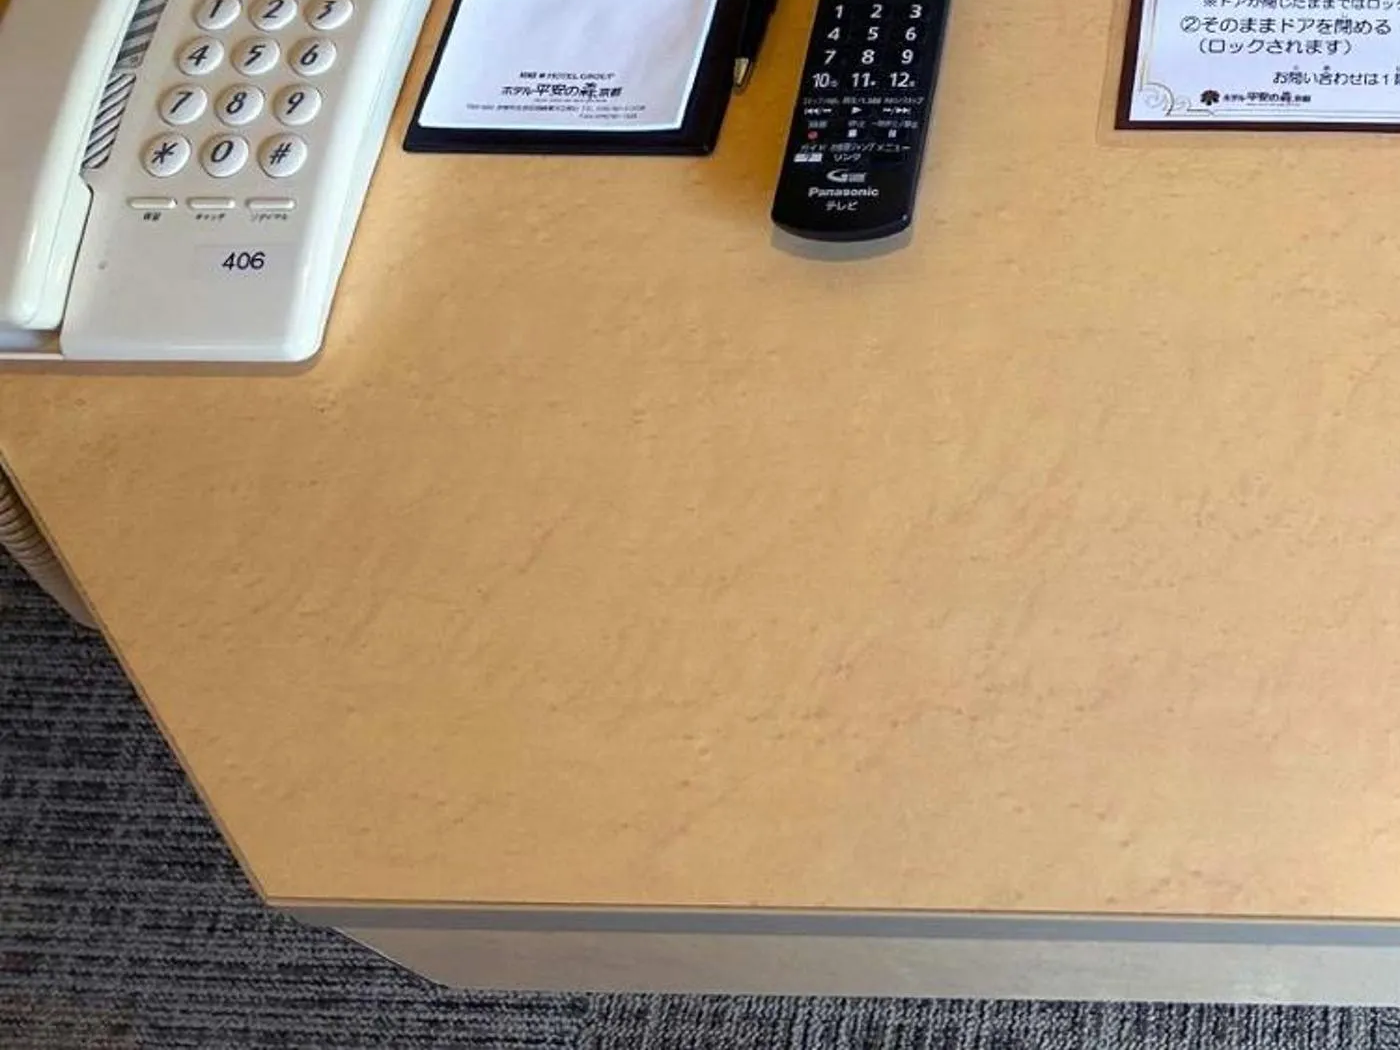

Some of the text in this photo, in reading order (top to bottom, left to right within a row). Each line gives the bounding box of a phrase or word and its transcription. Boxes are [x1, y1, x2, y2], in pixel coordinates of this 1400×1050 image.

[209, 0, 222, 20] 1
[317, 0, 336, 20] 3
[835, 4, 843, 19] 1
[869, 4, 882, 19] 2
[909, 4, 922, 19] 3
[827, 27, 841, 41] 4
[867, 27, 879, 41] 5
[905, 27, 917, 41] 6
[188, 44, 208, 66] 4
[245, 44, 266, 67] 5
[300, 44, 318, 66] 6
[824, 50, 836, 64] 7
[861, 49, 875, 64] 8
[901, 49, 914, 64] 9
[547, 72, 578, 80] HOTEL
[580, 72, 615, 80] GROUP
[170, 92, 192, 114] 7
[226, 91, 247, 114] 8
[286, 92, 304, 114] 9
[211, 140, 232, 163] 0
[269, 143, 291, 163] #
[808, 186, 879, 198] Panasonic
[826, 200, 859, 211] テレビ
[222, 251, 266, 270] 406
